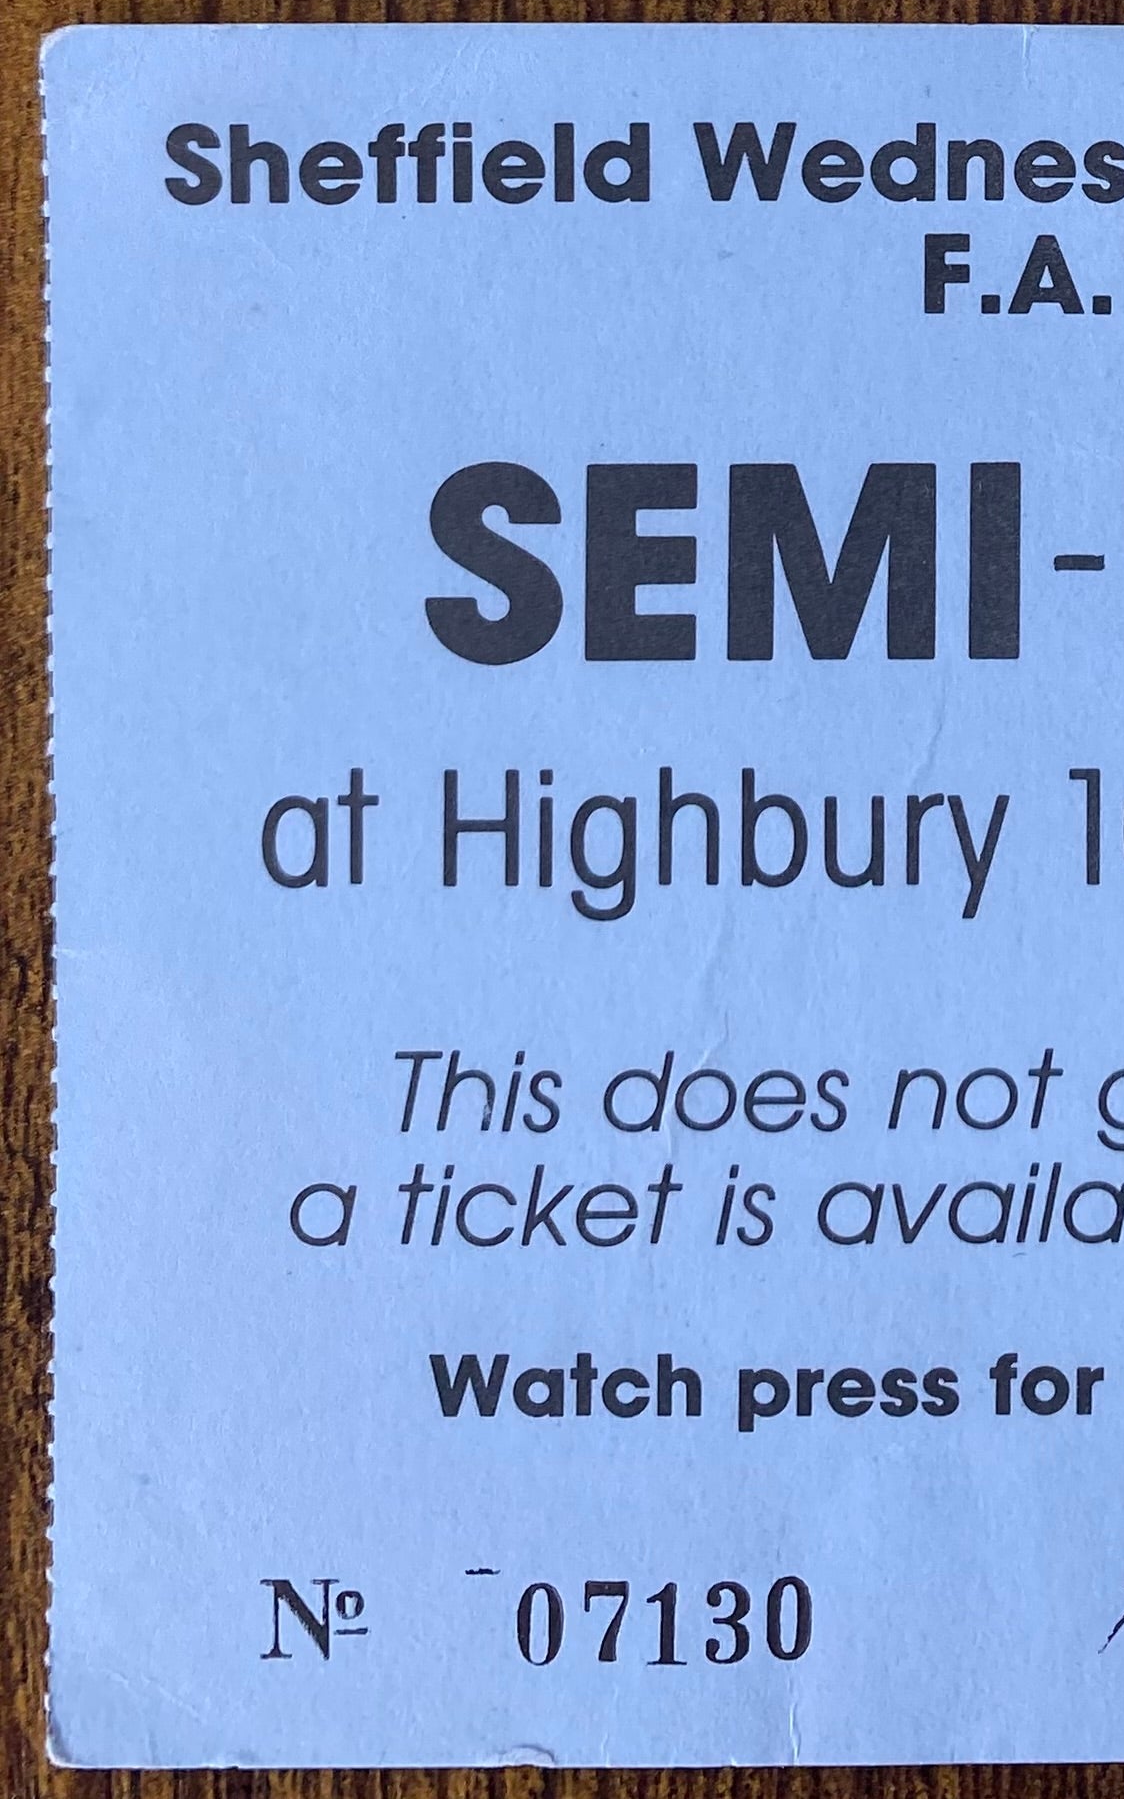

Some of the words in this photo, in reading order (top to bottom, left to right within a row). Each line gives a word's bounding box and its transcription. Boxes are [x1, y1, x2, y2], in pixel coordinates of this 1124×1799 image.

[164, 121, 651, 206] Sheffield
[923, 233, 1112, 315] F.A.
[261, 767, 380, 889] at
[442, 766, 1010, 922] Highbury
[394, 1050, 562, 1134] This
[603, 1050, 850, 1133] does
[887, 1048, 1064, 1131] not
[289, 1183, 357, 1247] a
[398, 1163, 683, 1248] ticket
[715, 1164, 776, 1247] is
[428, 1352, 702, 1419] Watch
[738, 1367, 960, 1433] press
[989, 1352, 1105, 1416] for
[516, 1575, 812, 1666] 07130
